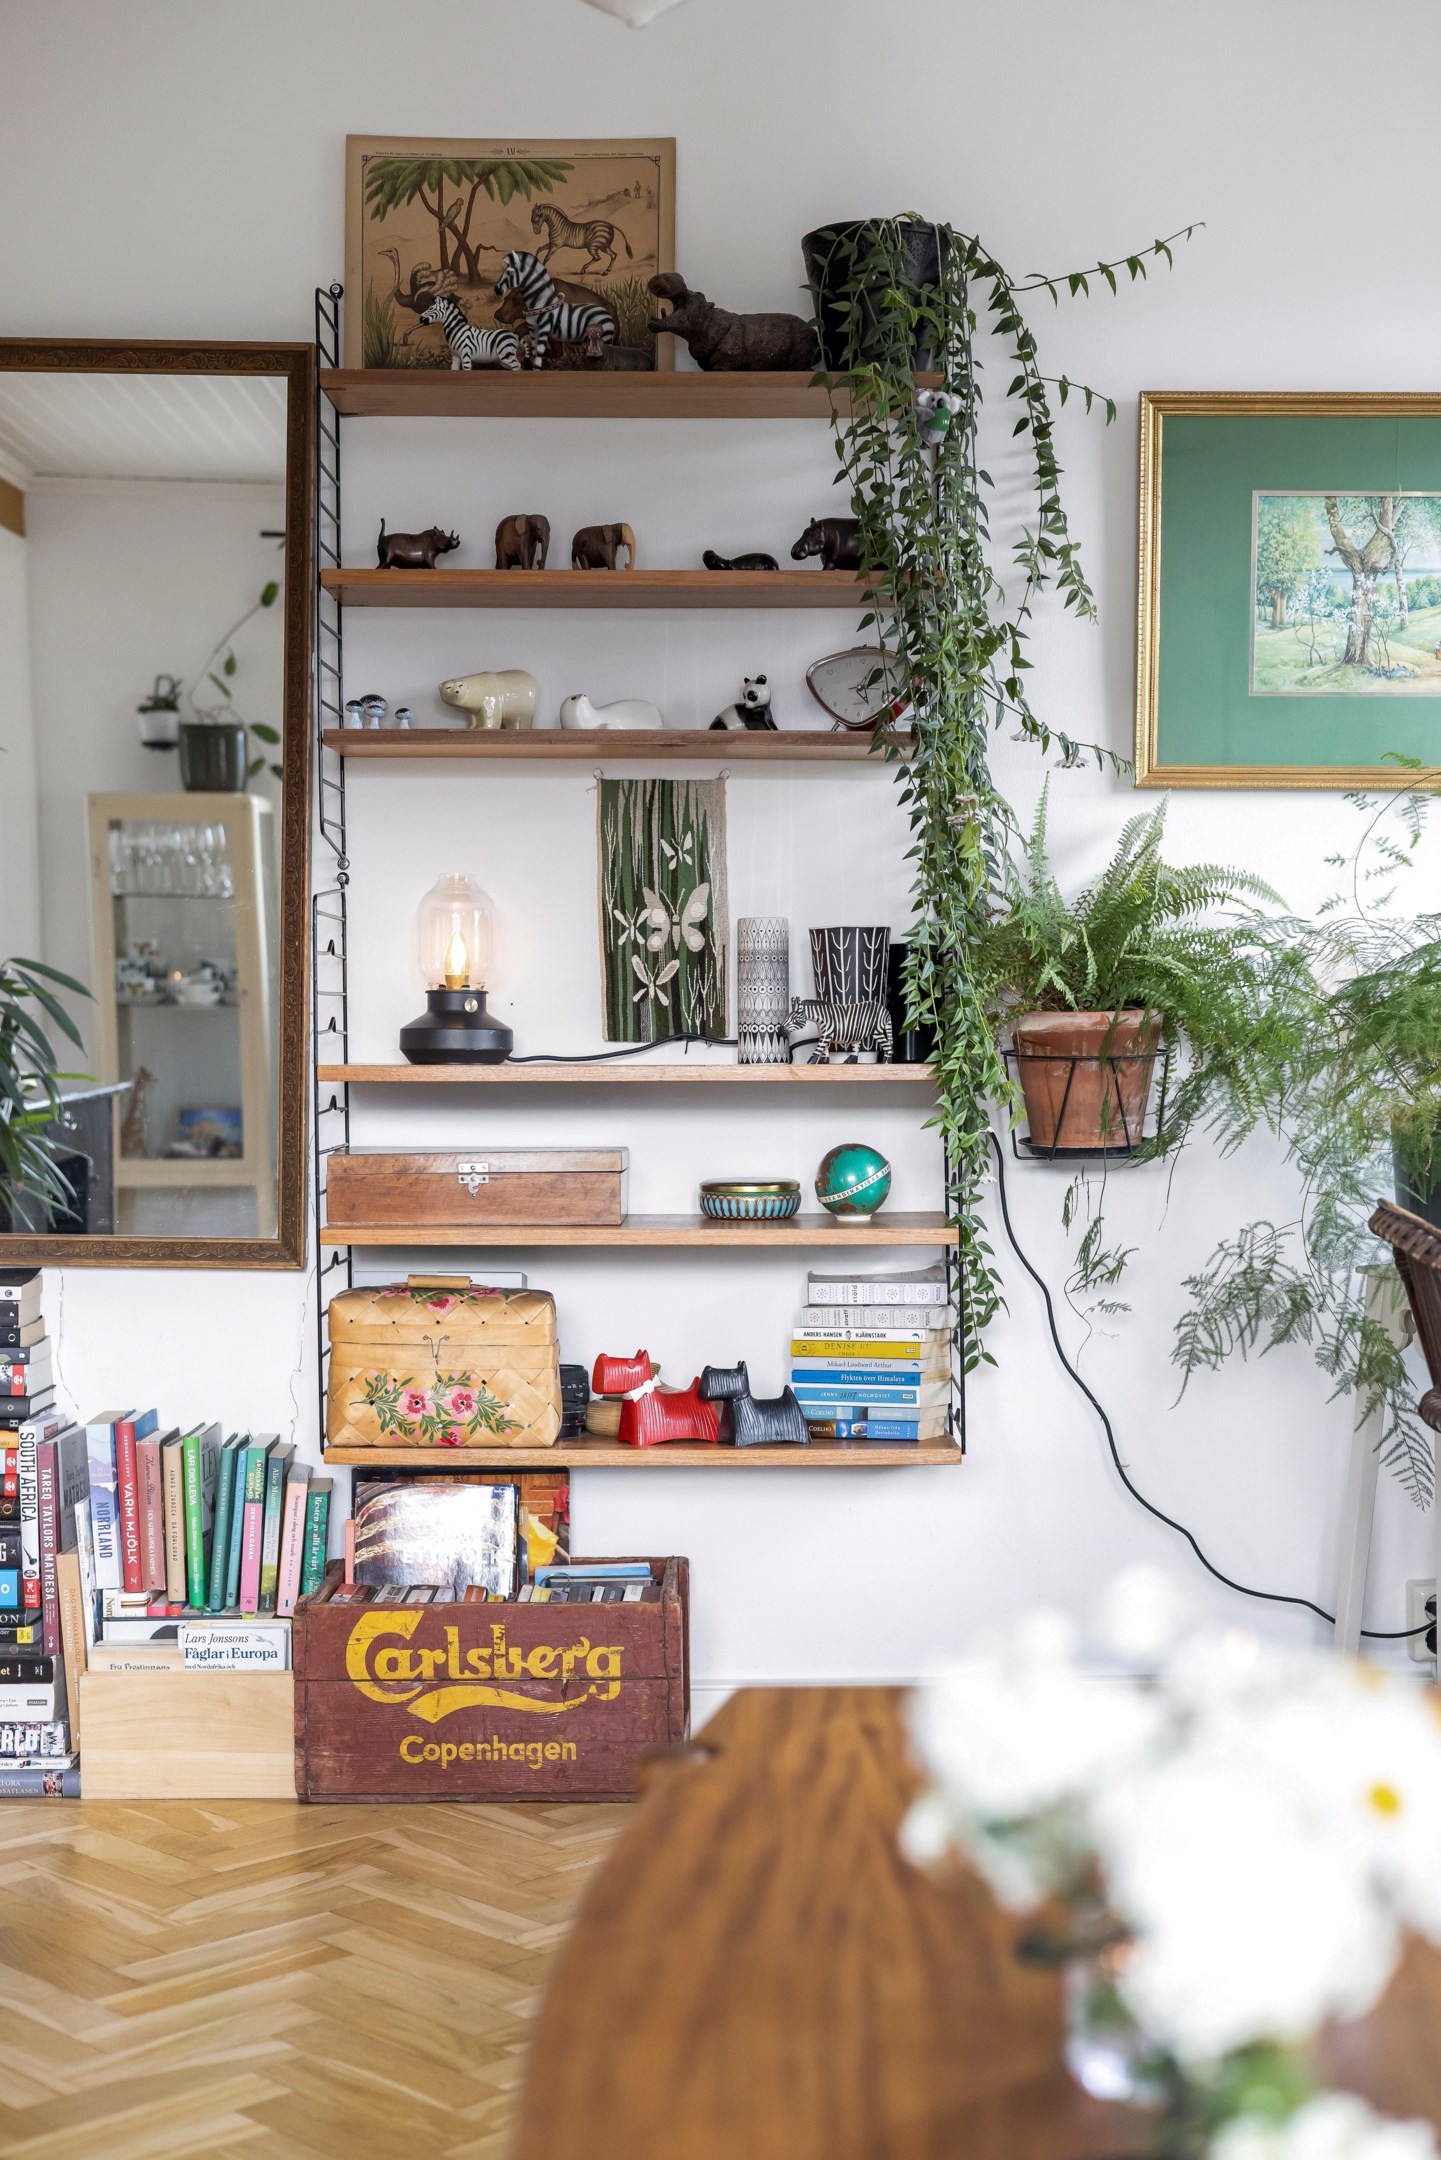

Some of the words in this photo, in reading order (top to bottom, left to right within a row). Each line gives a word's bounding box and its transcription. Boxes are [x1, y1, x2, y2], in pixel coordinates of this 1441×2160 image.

[824, 1174, 880, 1202] SKANDINAVISKA
[824, 1342, 857, 1350] DENISE
[855, 1331, 887, 1339] HJÄRNSTARK
[841, 1374, 863, 1382] Flykten
[877, 1374, 906, 1384] Himalaya
[20, 1432, 36, 1474] SOUTH
[188, 1450, 197, 1466] LÄR
[145, 1454, 155, 1484] Karen
[188, 1468, 197, 1483] DIG
[254, 1459, 262, 1500] ABDULRAZAK
[272, 1468, 280, 1484] Alice
[41, 1468, 52, 1500] TAREQ
[188, 1484, 198, 1506] LEVA
[20, 1478, 37, 1523] AFRICA
[124, 1482, 135, 1517] VARM
[270, 1486, 278, 1508] Munro
[293, 1495, 301, 1517] Svampar
[314, 1496, 322, 1522] Resten
[42, 1504, 55, 1548] TAYLORS
[96, 1502, 113, 1558] NORRLAND
[314, 1524, 320, 1532] av
[126, 1522, 138, 1564] MJÖLK
[248, 1538, 256, 1560] GÅVAN
[312, 1533, 320, 1546] allt
[312, 1546, 319, 1554] är
[44, 1552, 56, 1600] MATRESA
[214, 1545, 222, 1588] DETALJERNA
[70, 1606, 81, 1663] HAMMARSKJÖLD
[185, 1634, 206, 1644] Lars
[208, 1634, 249, 1645] Jonssons
[185, 1647, 224, 1661] Fåglar
[232, 1647, 278, 1661] Europa
[346, 1610, 625, 1704] Carlsberg
[0, 1666, 10, 1676] et
[124, 1663, 171, 1671] Prostinnans
[400, 1735, 577, 1770] Copenhagen
